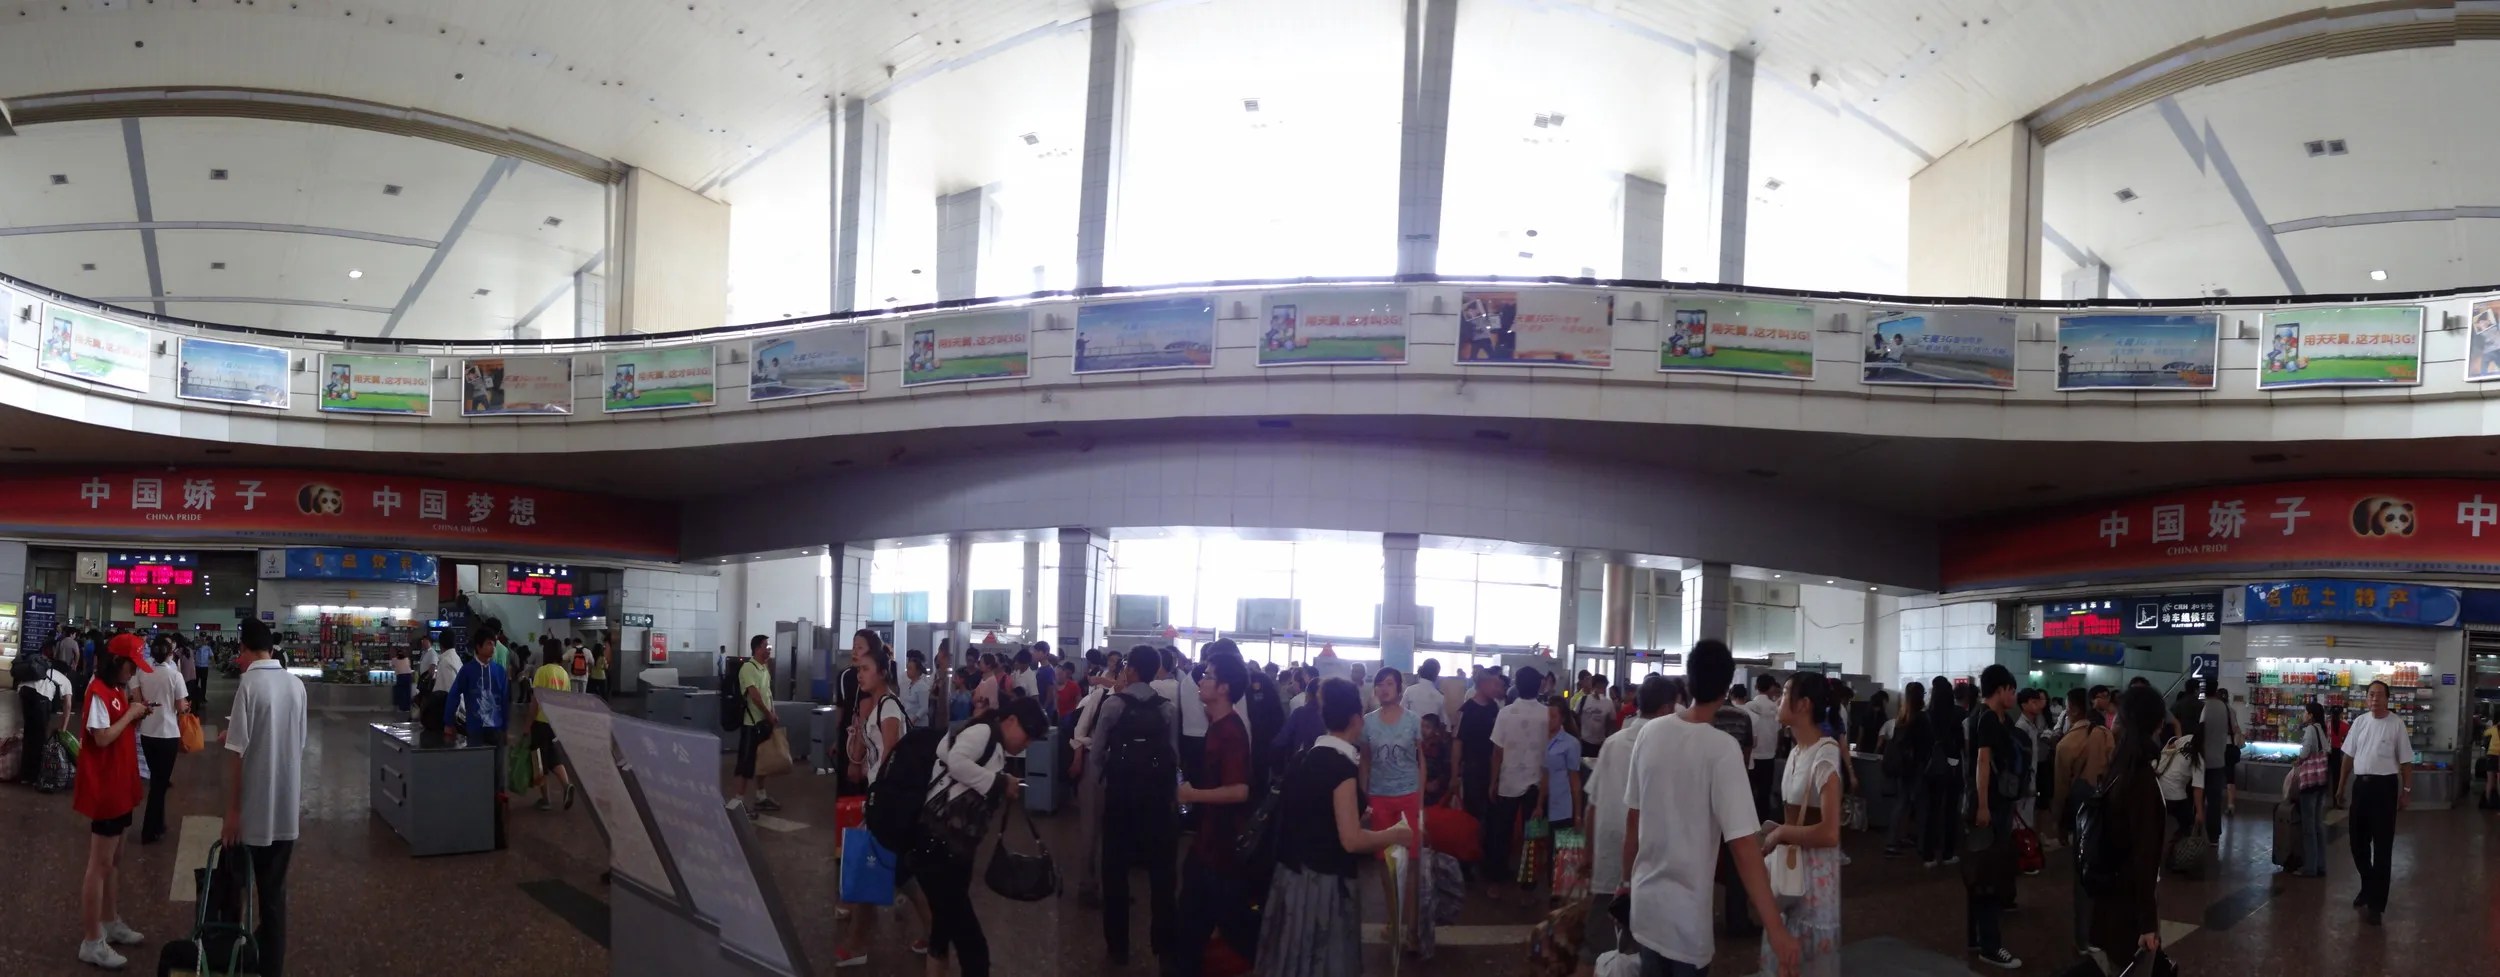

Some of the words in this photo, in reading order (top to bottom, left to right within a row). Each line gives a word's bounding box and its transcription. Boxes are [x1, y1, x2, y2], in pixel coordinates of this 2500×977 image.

[81, 477, 267, 511] 中国娇子
[372, 485, 536, 526] 中国梦想
[145, 513, 175, 521] CHINA
[176, 513, 203, 521] PRIDE
[2099, 496, 2311, 549] 中国娇子
[2456, 493, 2498, 537] 中
[432, 523, 459, 532] CHINA
[460, 525, 489, 534] DREAM
[2166, 545, 2199, 556] CHINA
[2200, 543, 2229, 553] PRIDE
[28, 595, 37, 610] 1
[2266, 586, 2410, 609] 名优土特产
[2191, 656, 2204, 679] 2
